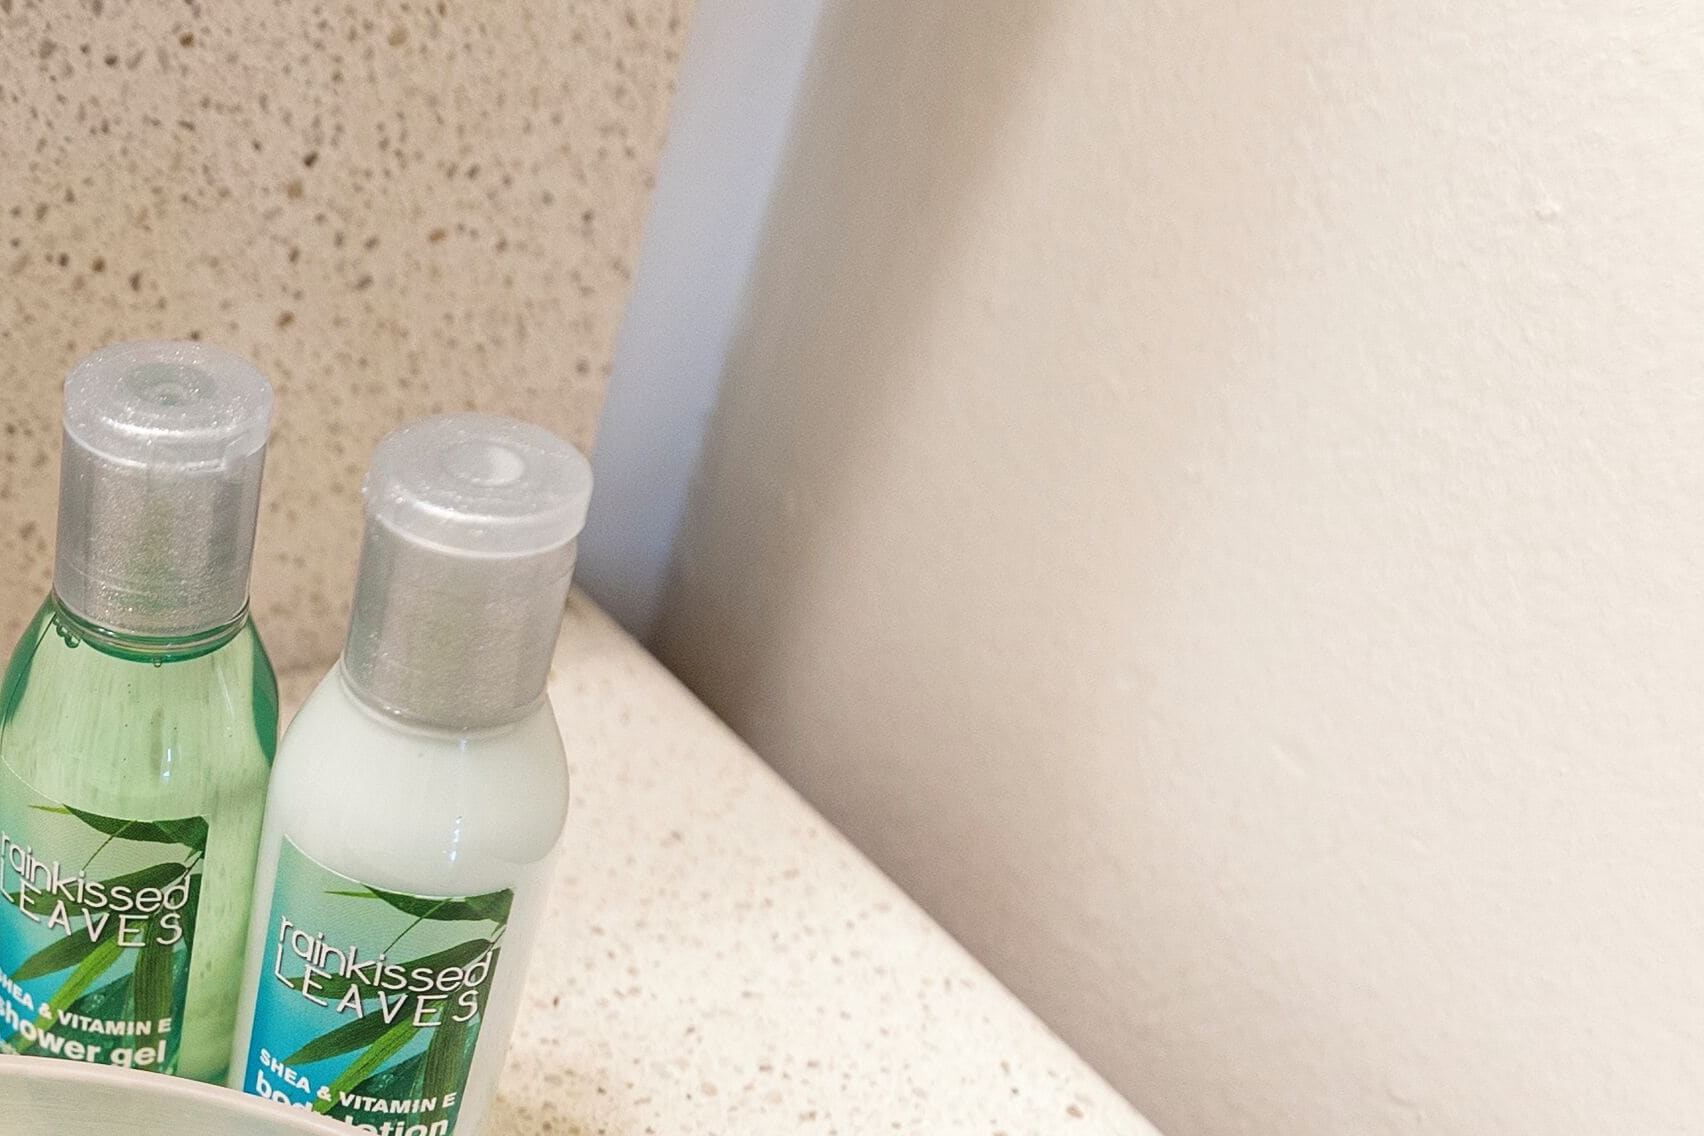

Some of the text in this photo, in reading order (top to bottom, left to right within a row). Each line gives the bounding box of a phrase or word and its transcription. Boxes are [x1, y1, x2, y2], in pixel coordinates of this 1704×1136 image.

[0, 857, 184, 948] LEAVES
[1, 831, 191, 912] rainkissed
[274, 943, 479, 1028] LEAVES
[278, 915, 493, 992] rainkissed
[38, 1003, 53, 1020] &
[58, 1009, 152, 1036] VITAMIN
[157, 1018, 172, 1033] E
[110, 1040, 167, 1069] gel
[259, 1048, 457, 1114] SHEA & VITAMIN E
